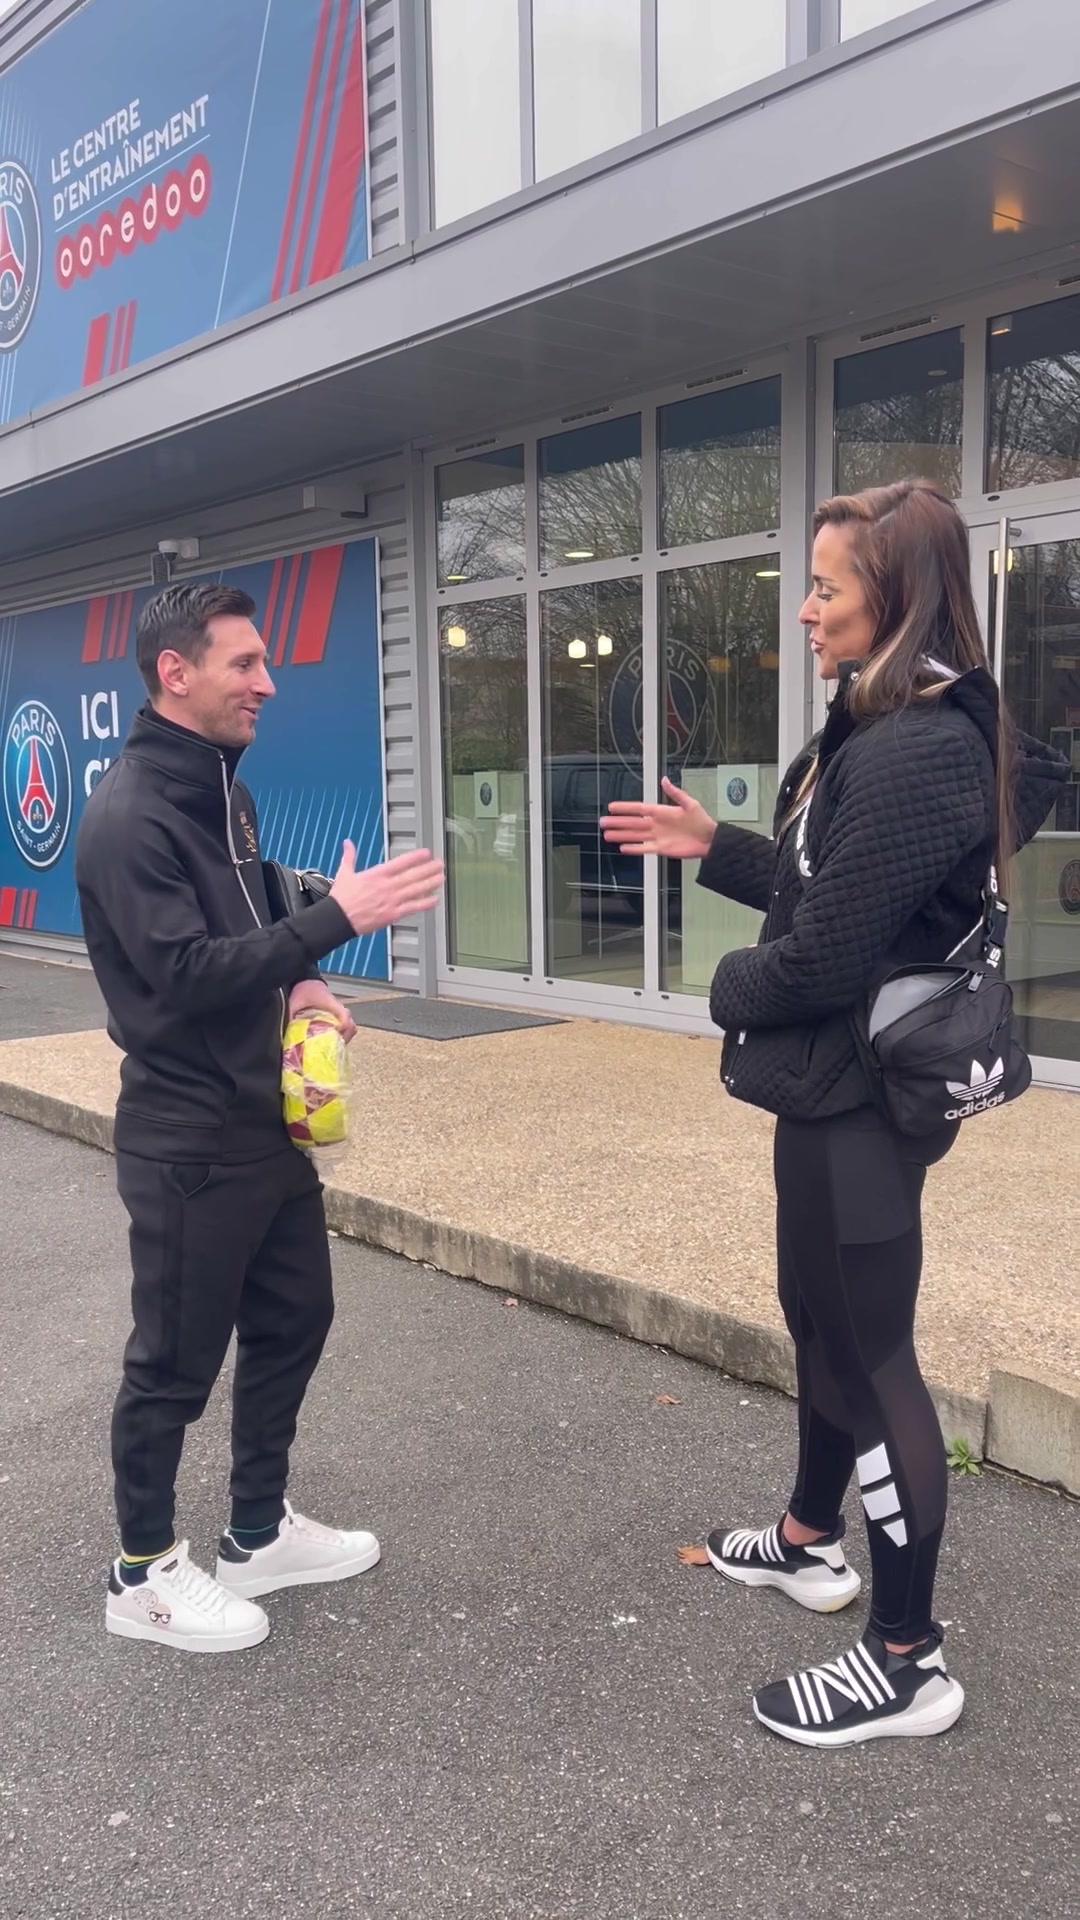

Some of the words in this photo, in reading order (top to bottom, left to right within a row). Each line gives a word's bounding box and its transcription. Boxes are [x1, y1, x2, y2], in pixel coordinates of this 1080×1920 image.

[51, 148, 72, 185] LE
[73, 98, 142, 169] CENTRE
[53, 94, 209, 222] D'ENTRAÎNEMENT
[0, 171, 25, 205] RIS
[60, 168, 206, 278] ooredoo
[627, 646, 700, 681] PRIS
[11, 708, 56, 749] PARIS
[80, 690, 120, 740] ICI
[944, 1090, 1006, 1120] adidas
